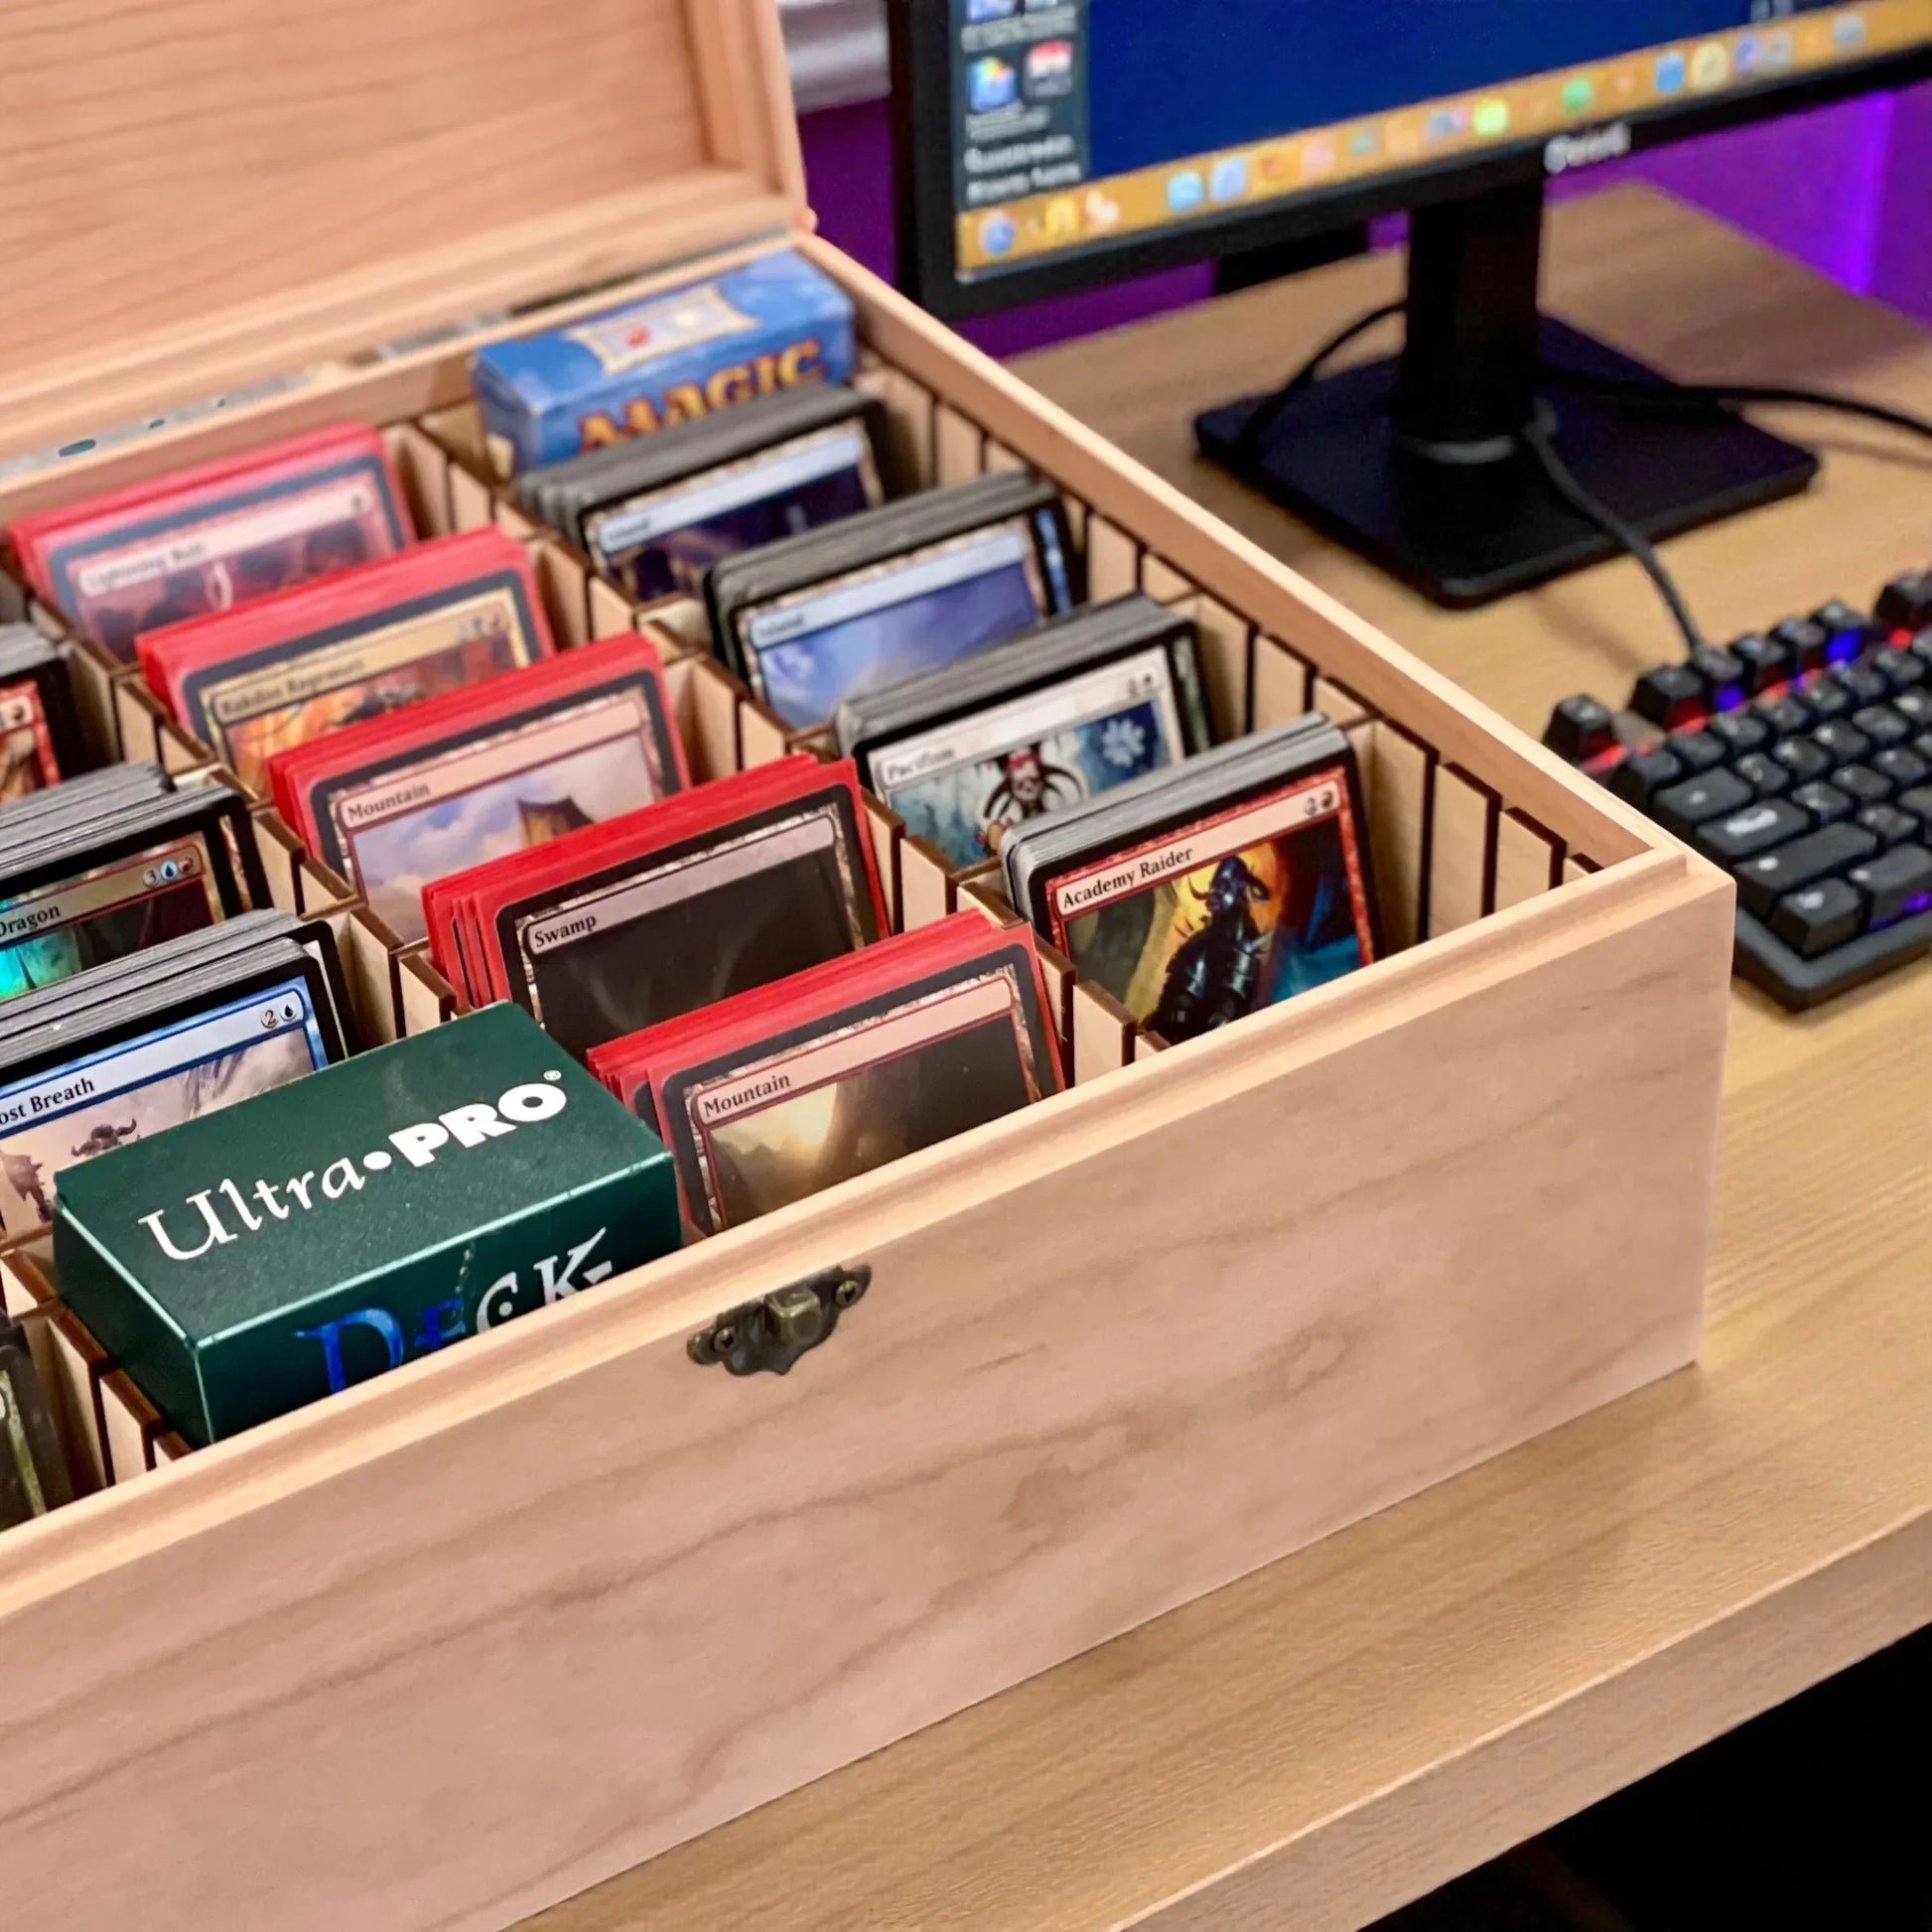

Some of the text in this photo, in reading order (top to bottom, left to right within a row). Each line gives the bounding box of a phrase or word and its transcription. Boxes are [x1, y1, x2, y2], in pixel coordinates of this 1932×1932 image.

[576, 336, 827, 458] MAGIC
[346, 781, 431, 822] Mountain
[1061, 847, 1193, 909] Academy Raider
[534, 915, 598, 948] Swamp
[30, 1077, 95, 1113] Breath
[703, 1074, 792, 1118] Mountain
